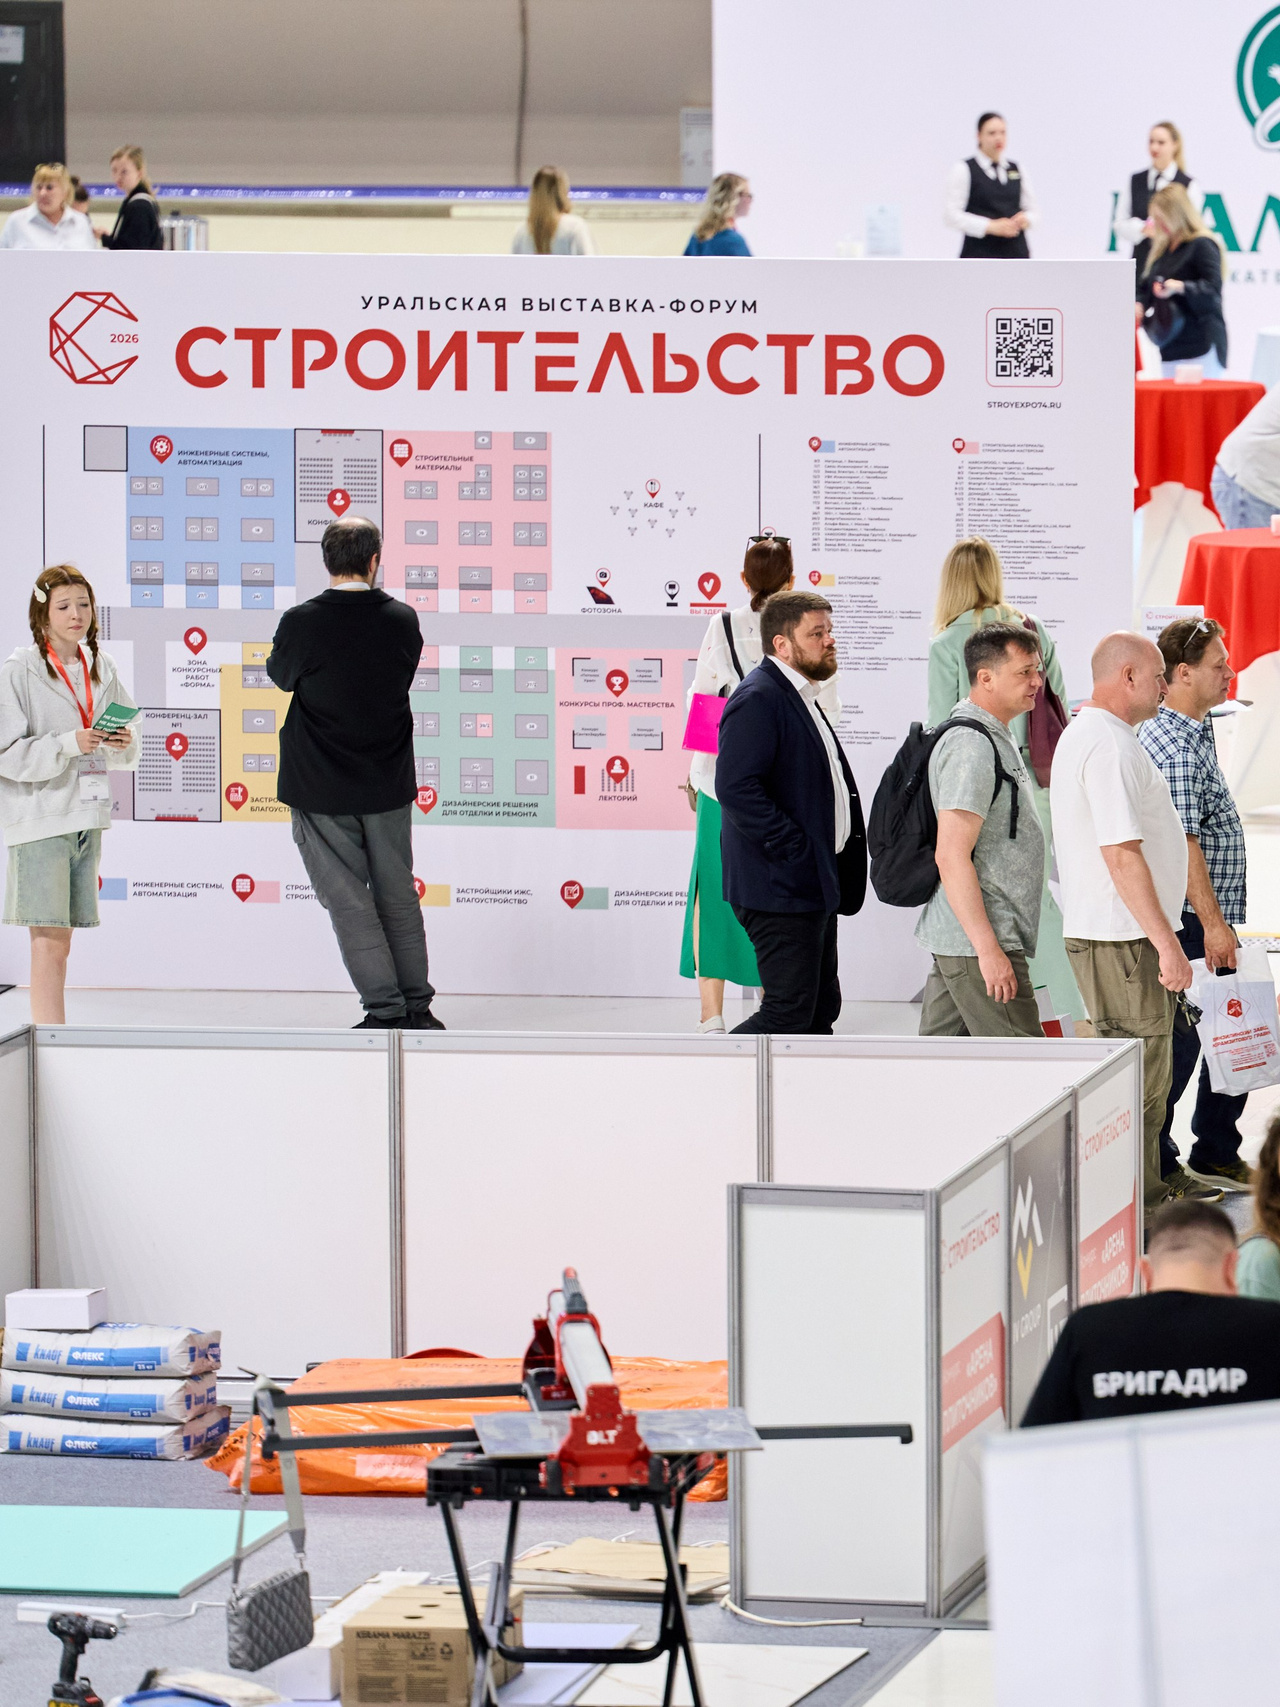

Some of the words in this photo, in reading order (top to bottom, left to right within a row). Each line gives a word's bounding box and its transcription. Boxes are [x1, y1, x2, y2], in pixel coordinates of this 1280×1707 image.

[361, 296, 507, 312] УРАЛЬСКАЯ
[522, 297, 758, 315] ВЫСТАВКА-ФОРУМ
[110, 333, 139, 344] 2026
[175, 326, 945, 397] СТРОИТЕЛЬСТВО
[456, 886, 511, 895] ЗАСТРОЙЩИКИ
[614, 889, 674, 898] ДИЗАЙНЕРСКИЕ
[456, 896, 528, 904] БЛАГОУСТРОЙСТВО
[1084, 1109, 1131, 1161] СТРОИТЕЛЬСТВО
[948, 1212, 1000, 1269] СТРОИТЕЛЬСТВО
[72, 1350, 104, 1361] ФЛЕКС
[1092, 1368, 1248, 1398] БРИГАДИР
[67, 1395, 99, 1406] ФЛЕКС
[65, 1439, 98, 1450] ФЛЕКС
[356, 1631, 390, 1639] KERAMA
[393, 1631, 431, 1640] MARAZZI
